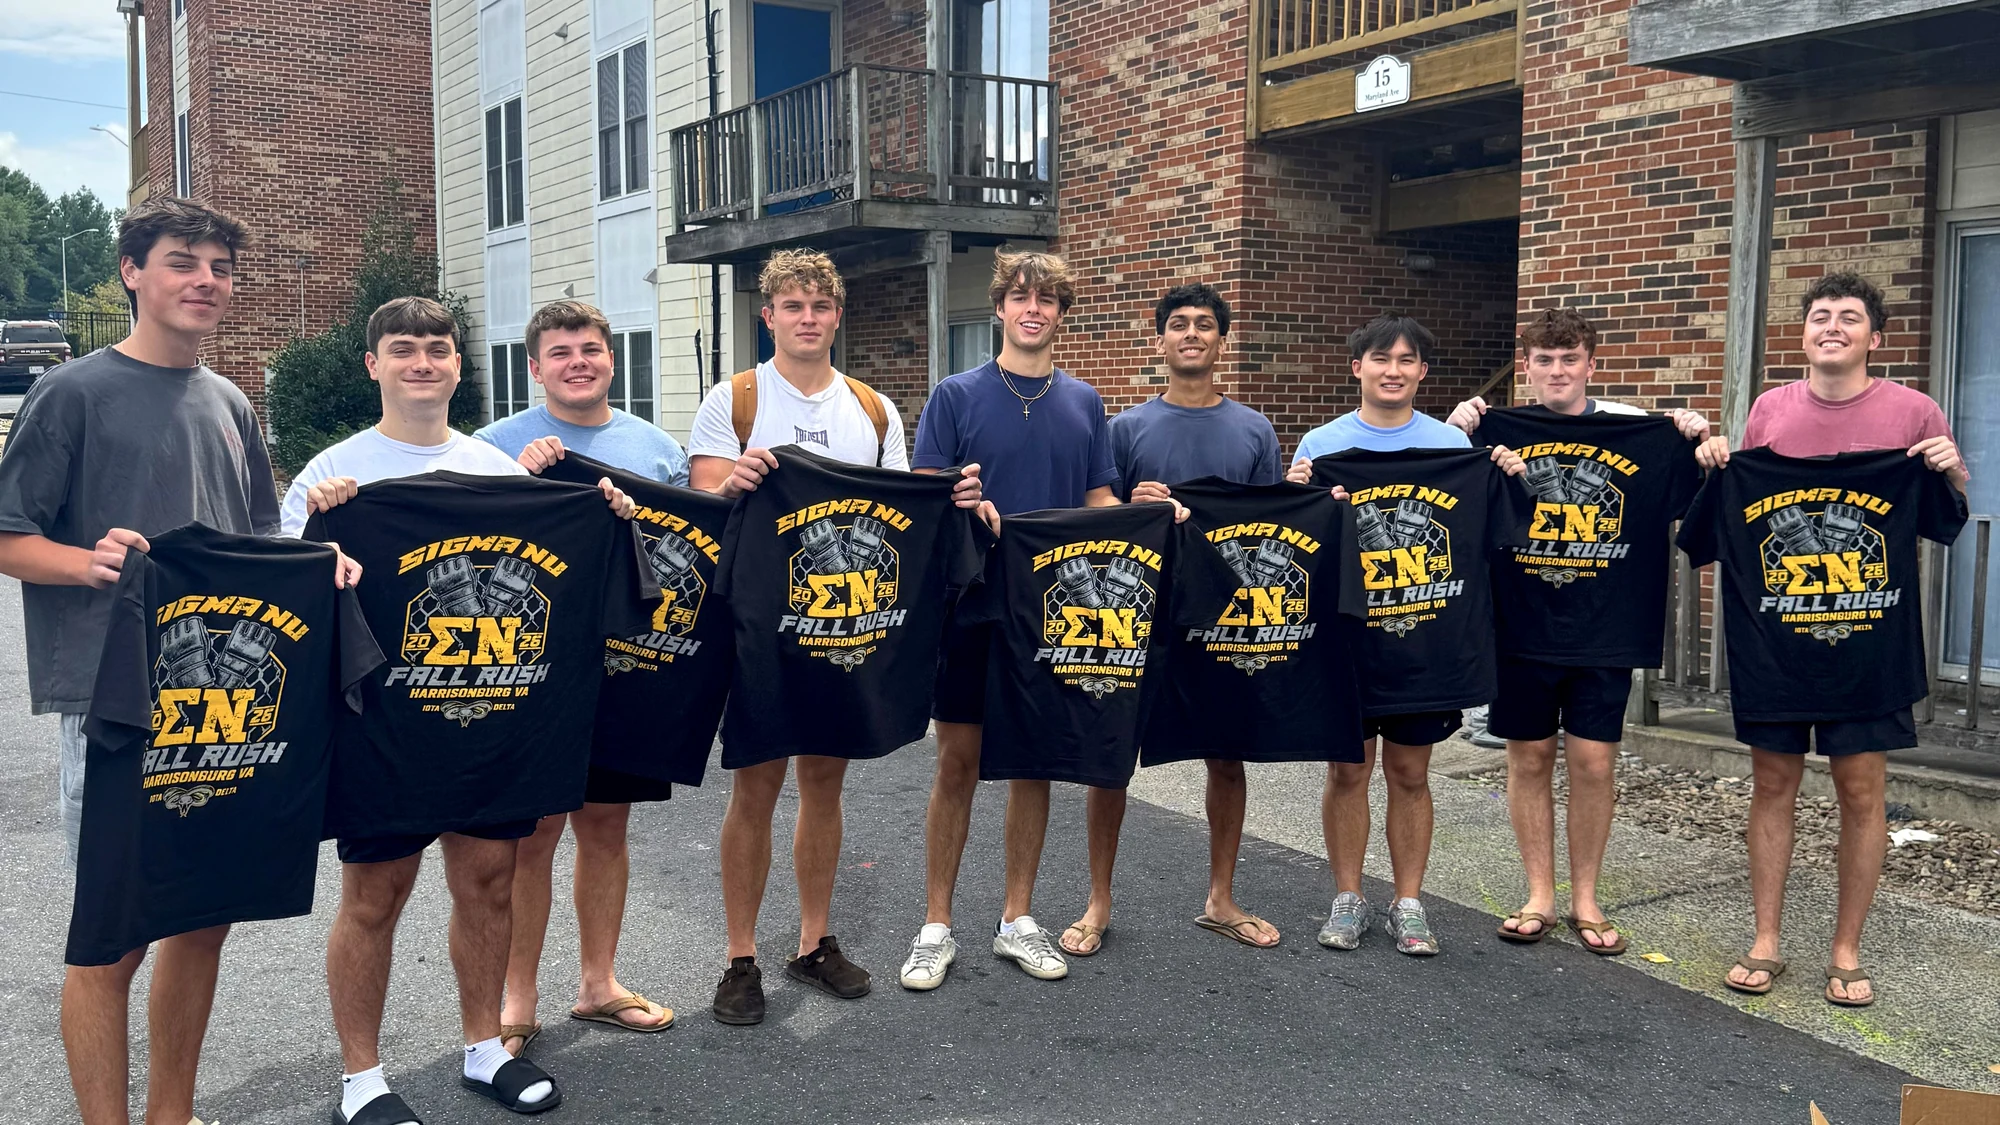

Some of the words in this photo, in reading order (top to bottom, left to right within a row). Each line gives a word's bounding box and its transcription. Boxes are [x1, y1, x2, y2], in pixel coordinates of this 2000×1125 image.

[1375, 68, 1390, 88] 15
[1365, 89, 1388, 102] Maryland
[808, 429, 829, 449] DELTA
[1597, 449, 1640, 476] NU
[1351, 484, 1415, 506] GMA
[1415, 486, 1459, 511] NU
[1743, 488, 1842, 524] SIGMA
[1844, 490, 1893, 516] NU
[775, 499, 873, 536] SIGMA
[873, 503, 913, 532] NU
[1599, 519, 1618, 530] 26
[1204, 522, 1278, 543] IGMA
[1278, 526, 1321, 554] NU
[398, 536, 523, 575] SIGMA
[520, 541, 568, 577] NU
[1032, 540, 1129, 573] SIGMA
[1512, 540, 1559, 556] LL
[1564, 542, 1631, 558] RUSH
[1429, 557, 1448, 569] 26
[1515, 554, 1593, 567] HARRISONBURG
[1596, 559, 1608, 568] VA
[1767, 572, 1788, 582] 20
[1864, 565, 1883, 576] 26
[792, 589, 811, 601] 20
[878, 584, 895, 595] 26
[1366, 589, 1397, 606] LL
[1402, 580, 1464, 603] RUSH
[1759, 595, 1828, 612] FALL
[1833, 588, 1901, 610] RUSH
[1286, 600, 1304, 611] 26
[1368, 601, 1431, 616] RRISONBURG
[1433, 599, 1447, 609] VA
[260, 604, 310, 642] NU
[671, 608, 694, 622] 26
[778, 615, 848, 636] FALL
[853, 609, 907, 635] RUSH
[1781, 611, 1866, 622] HARRISONBURG
[1869, 610, 1883, 619] VA
[1047, 621, 1065, 632] 20
[1254, 623, 1317, 642] RUSH
[405, 635, 430, 648] 20
[521, 635, 542, 648] 26
[799, 631, 874, 647] HARRISONBURG
[876, 630, 886, 640] VA
[1206, 643, 1283, 652] HARRISONBURG
[1286, 642, 1299, 650] VA
[606, 638, 658, 659] SONBURG
[660, 652, 675, 663] VA
[1034, 648, 1099, 664] FALL
[1104, 649, 1148, 667] RUS
[384, 666, 470, 687] FALL
[475, 663, 551, 686] RUSH
[638, 662, 658, 672] DELTA
[1053, 665, 1131, 676] HARRISONBURG
[409, 687, 511, 699] HARRISONBURG
[514, 687, 529, 697] VA
[250, 708, 273, 723] 26
[422, 704, 440, 712] IOTA
[493, 703, 515, 711] DELTA
[142, 745, 191, 774] ALL
[197, 742, 289, 768] RUSH
[143, 769, 235, 789] HARRISONBURG
[239, 767, 254, 779] VA
[149, 793, 163, 803] IOTA
[215, 787, 237, 797] DELTA
